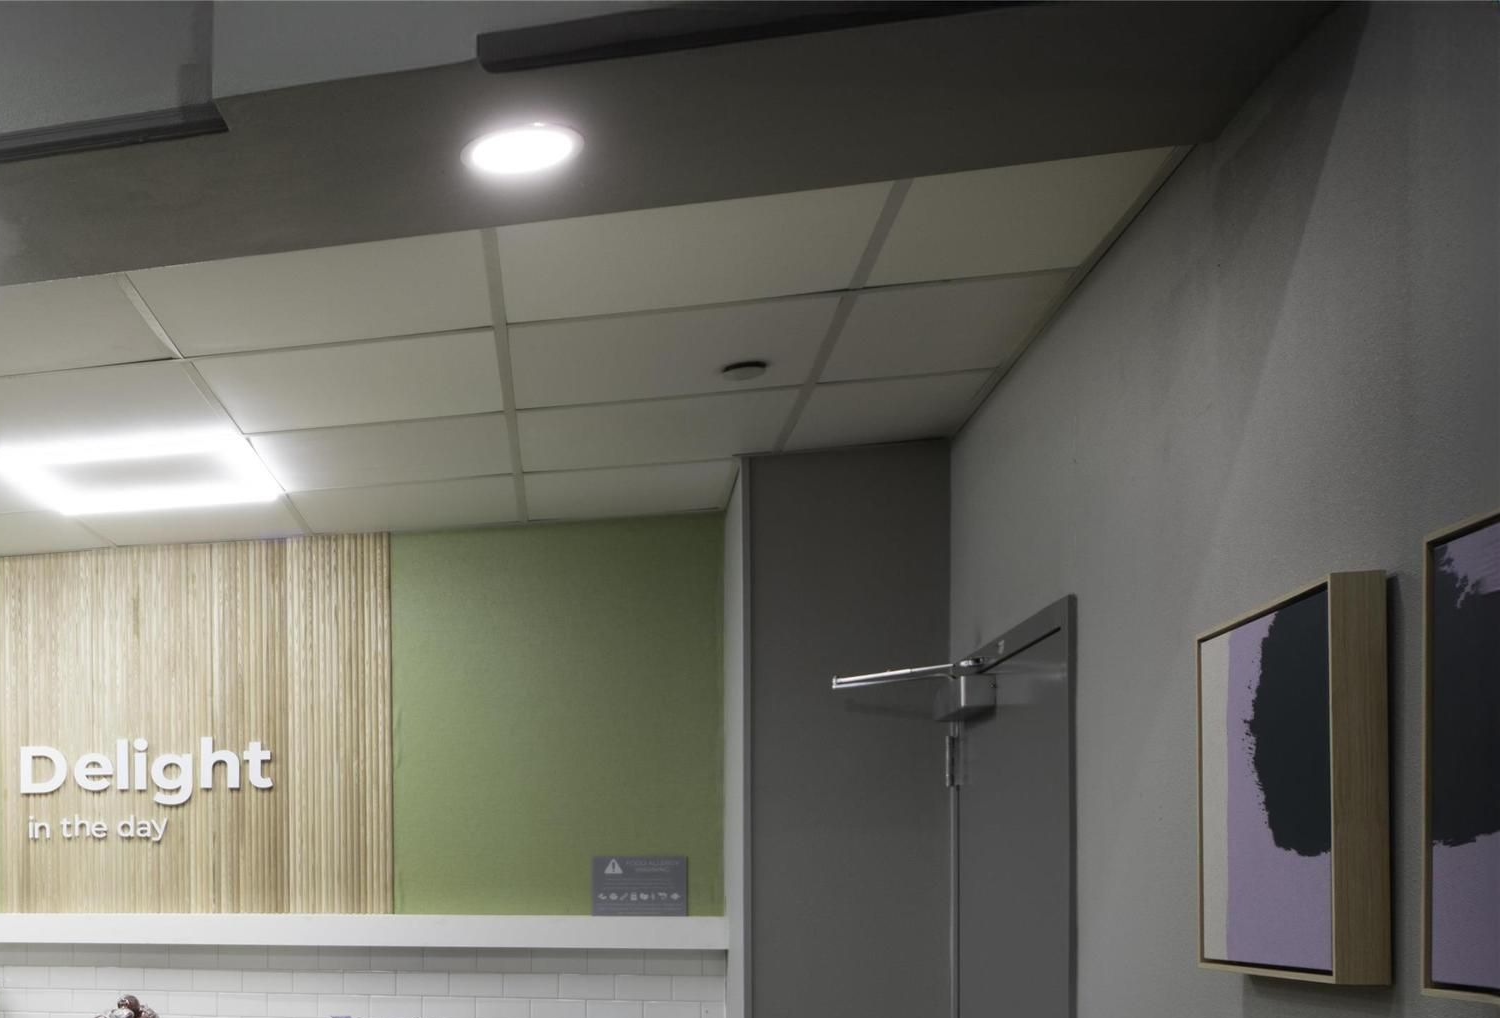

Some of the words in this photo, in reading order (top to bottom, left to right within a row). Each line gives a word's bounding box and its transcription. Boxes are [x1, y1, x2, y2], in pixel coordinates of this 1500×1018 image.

[20, 736, 273, 805] Delight
[28, 816, 51, 839] in
[60, 814, 109, 839] the
[117, 815, 169, 842] day
